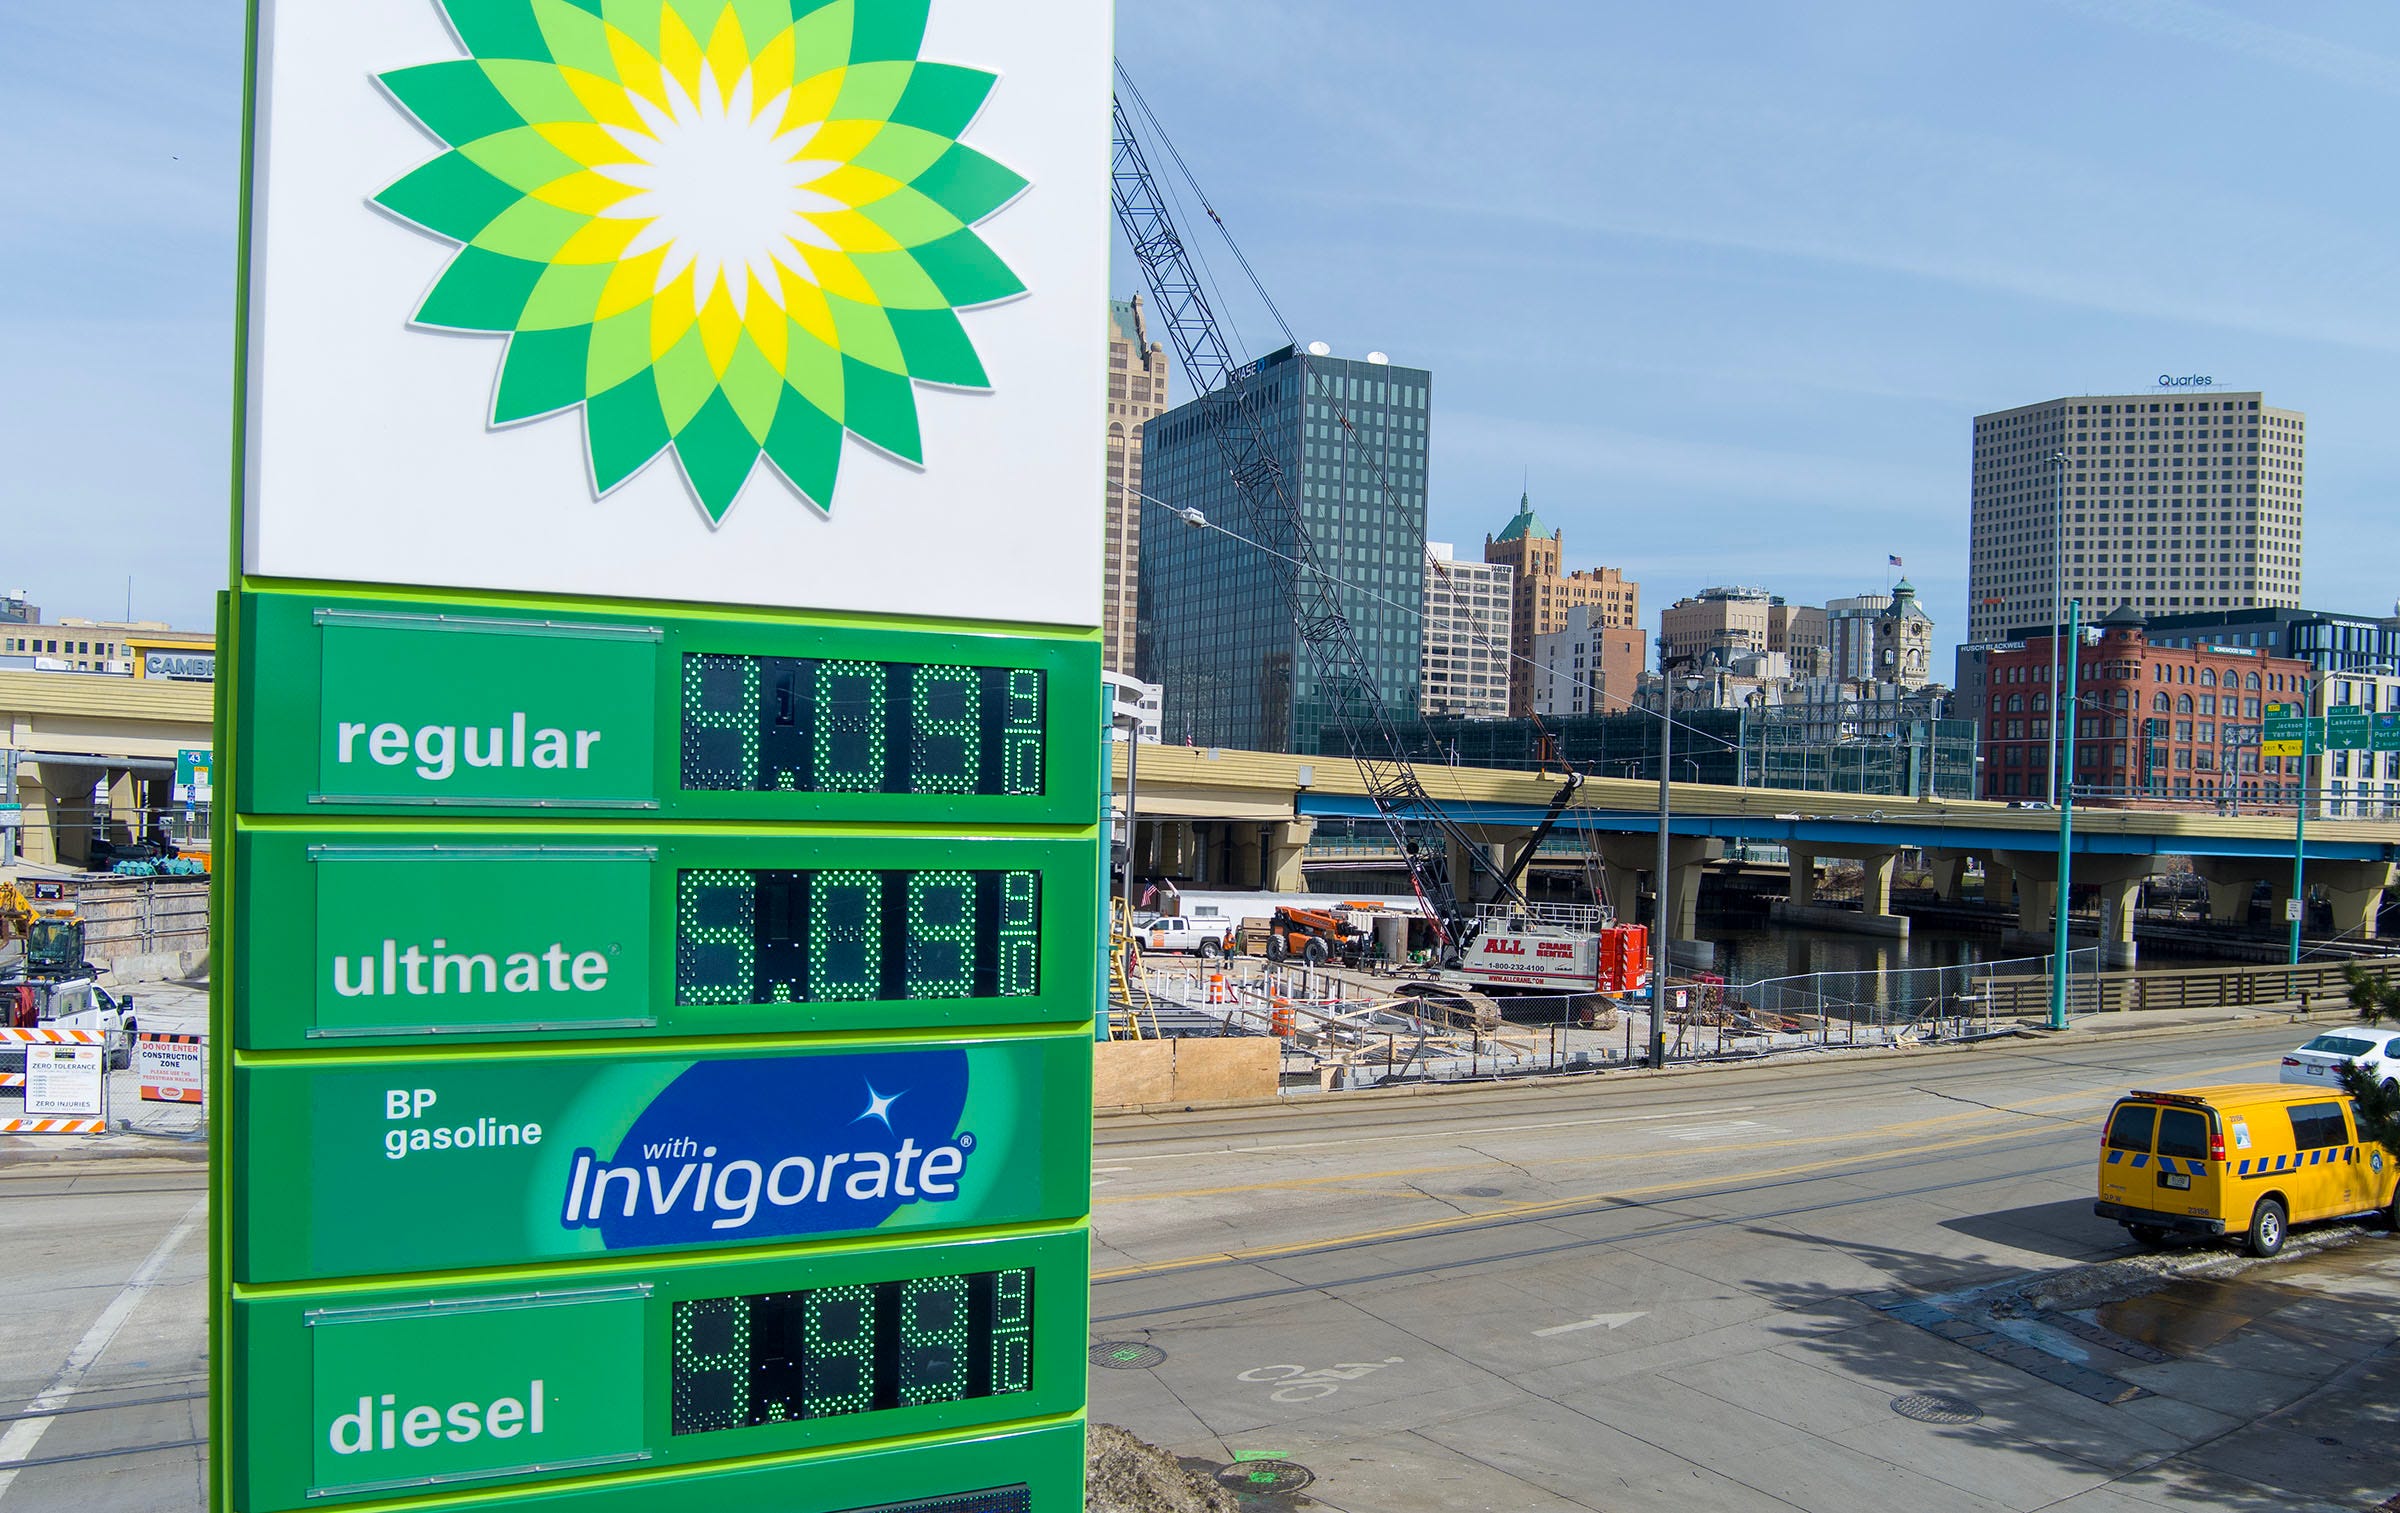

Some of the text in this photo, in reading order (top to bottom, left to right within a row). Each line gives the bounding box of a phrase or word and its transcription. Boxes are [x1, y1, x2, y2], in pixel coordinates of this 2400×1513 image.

[2158, 374, 2212, 386] Quarles
[1986, 641, 2026, 651] BLACKWELL
[337, 711, 601, 781] regular
[190, 754, 200, 762] 43
[1484, 939, 1525, 955] ALL
[1538, 942, 1573, 950] CRANE
[1536, 950, 1574, 959] RENTAL
[332, 938, 609, 998] ultimate
[1488, 962, 1545, 972] 1-800-232-4100
[155, 1043, 171, 1052] NOT
[172, 1045, 199, 1053] ENTER
[142, 1051, 199, 1061] CONSTRUCTION
[32, 1062, 97, 1071] ZERO TOLERANCE
[160, 1060, 181, 1068] ZONE
[35, 1100, 55, 1108] ZERO
[384, 1090, 438, 1120] BP
[384, 1119, 542, 1160] gasoline
[642, 1136, 698, 1162] with
[328, 1380, 545, 1457] diesel
